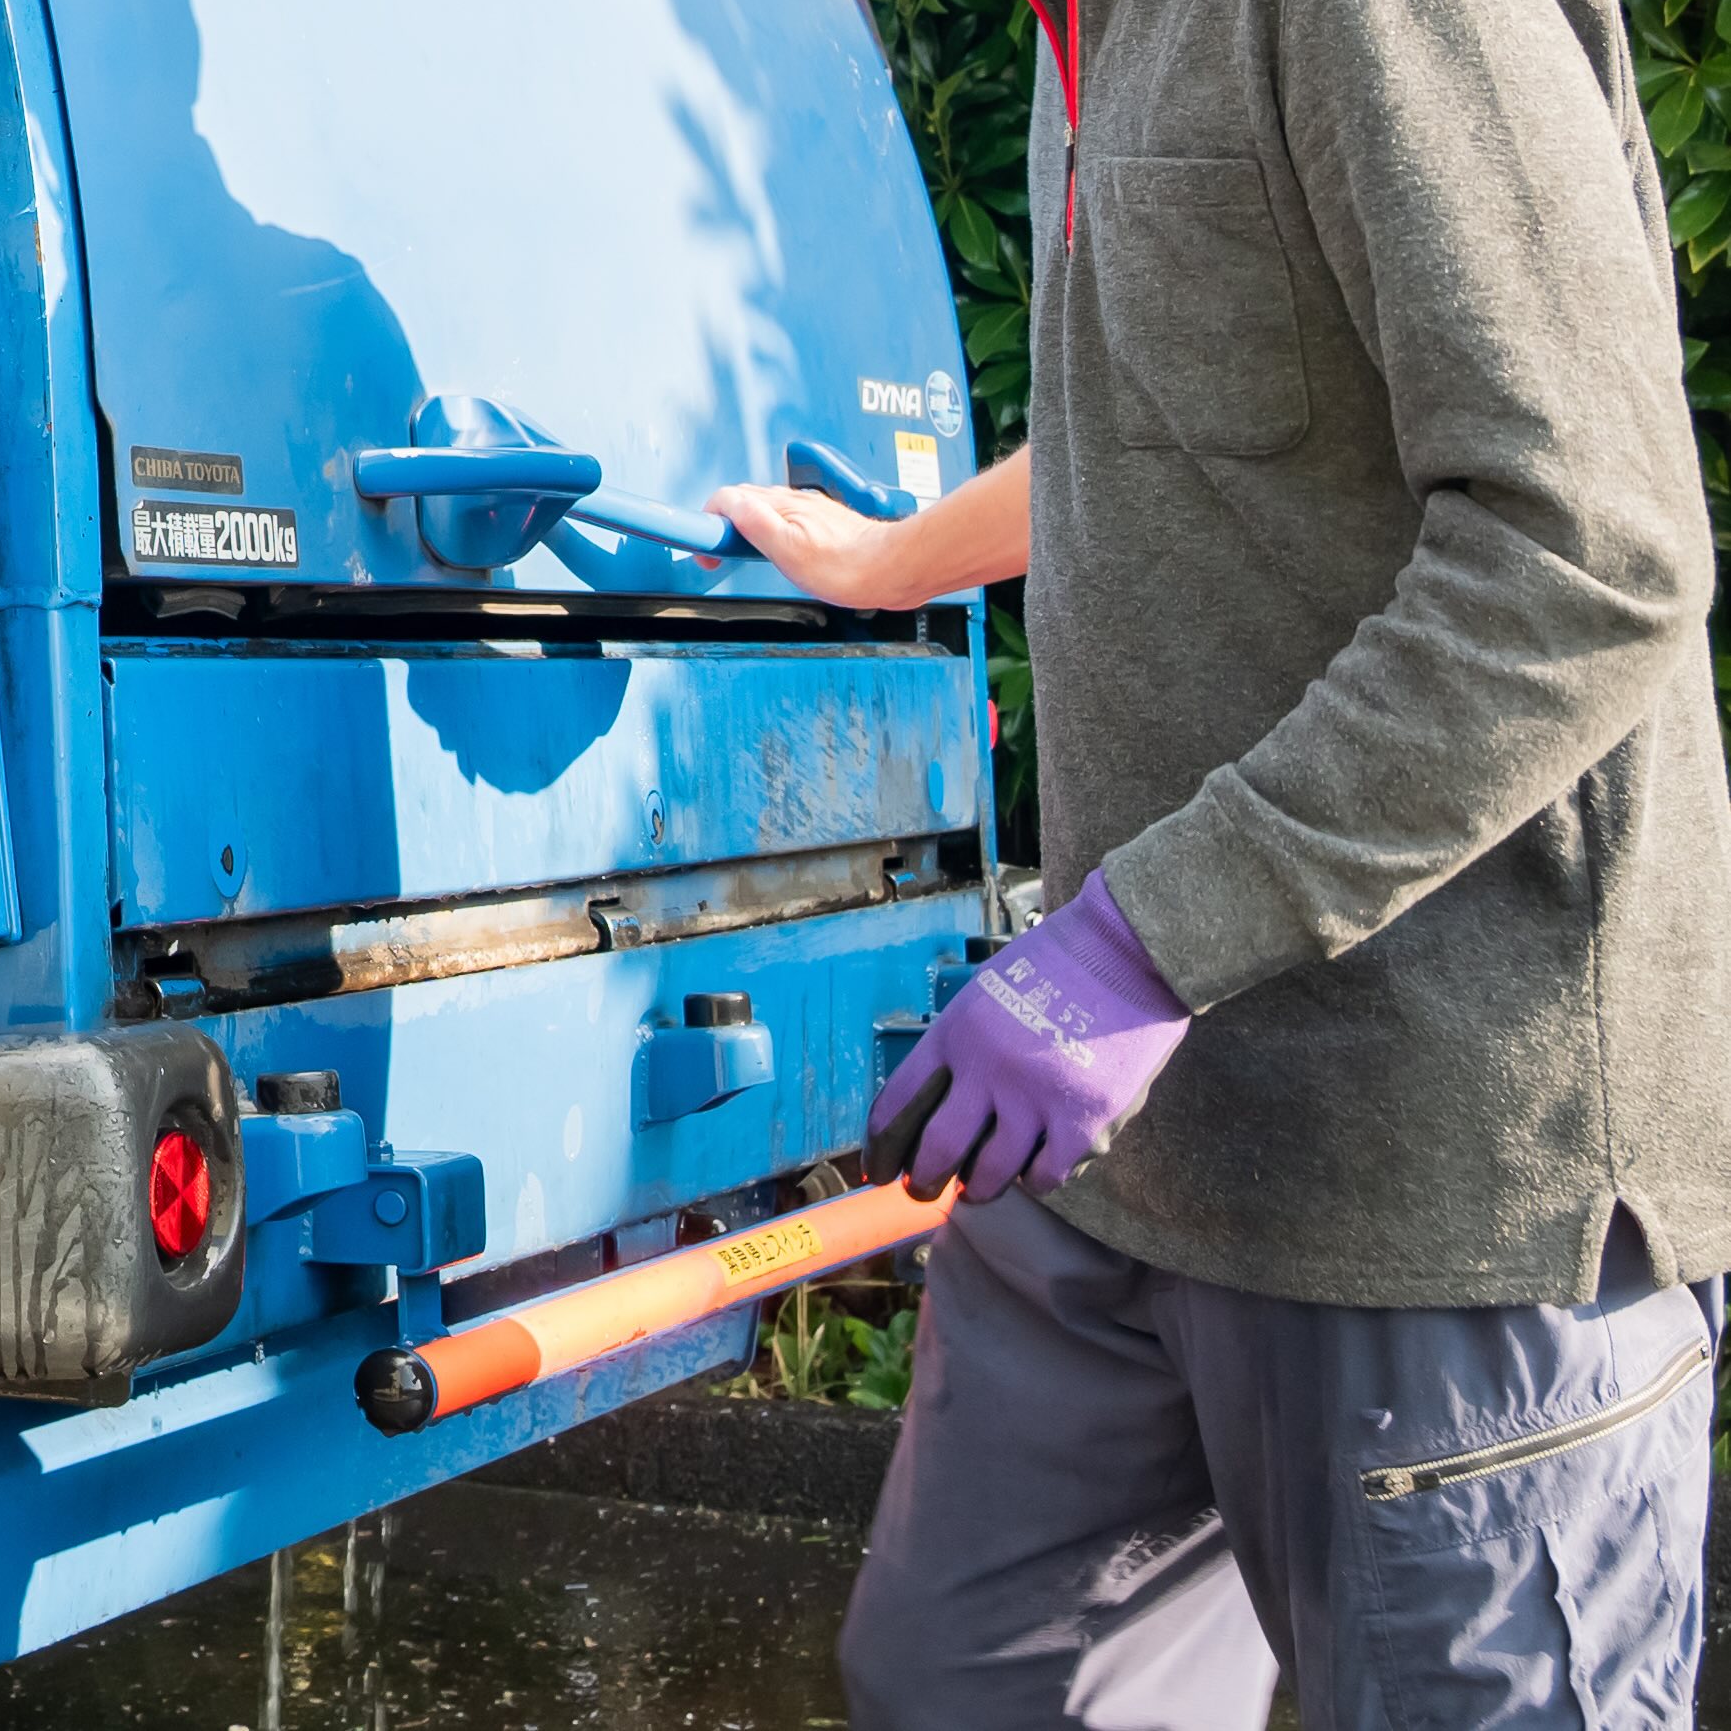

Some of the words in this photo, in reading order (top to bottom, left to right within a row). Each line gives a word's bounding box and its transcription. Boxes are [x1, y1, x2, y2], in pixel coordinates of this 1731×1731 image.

[861, 379, 922, 418] DYNA
[134, 456, 184, 480] CHIBA
[185, 461, 241, 485] TOYOTA
[134, 510, 298, 563] 最大積載量2000kg
